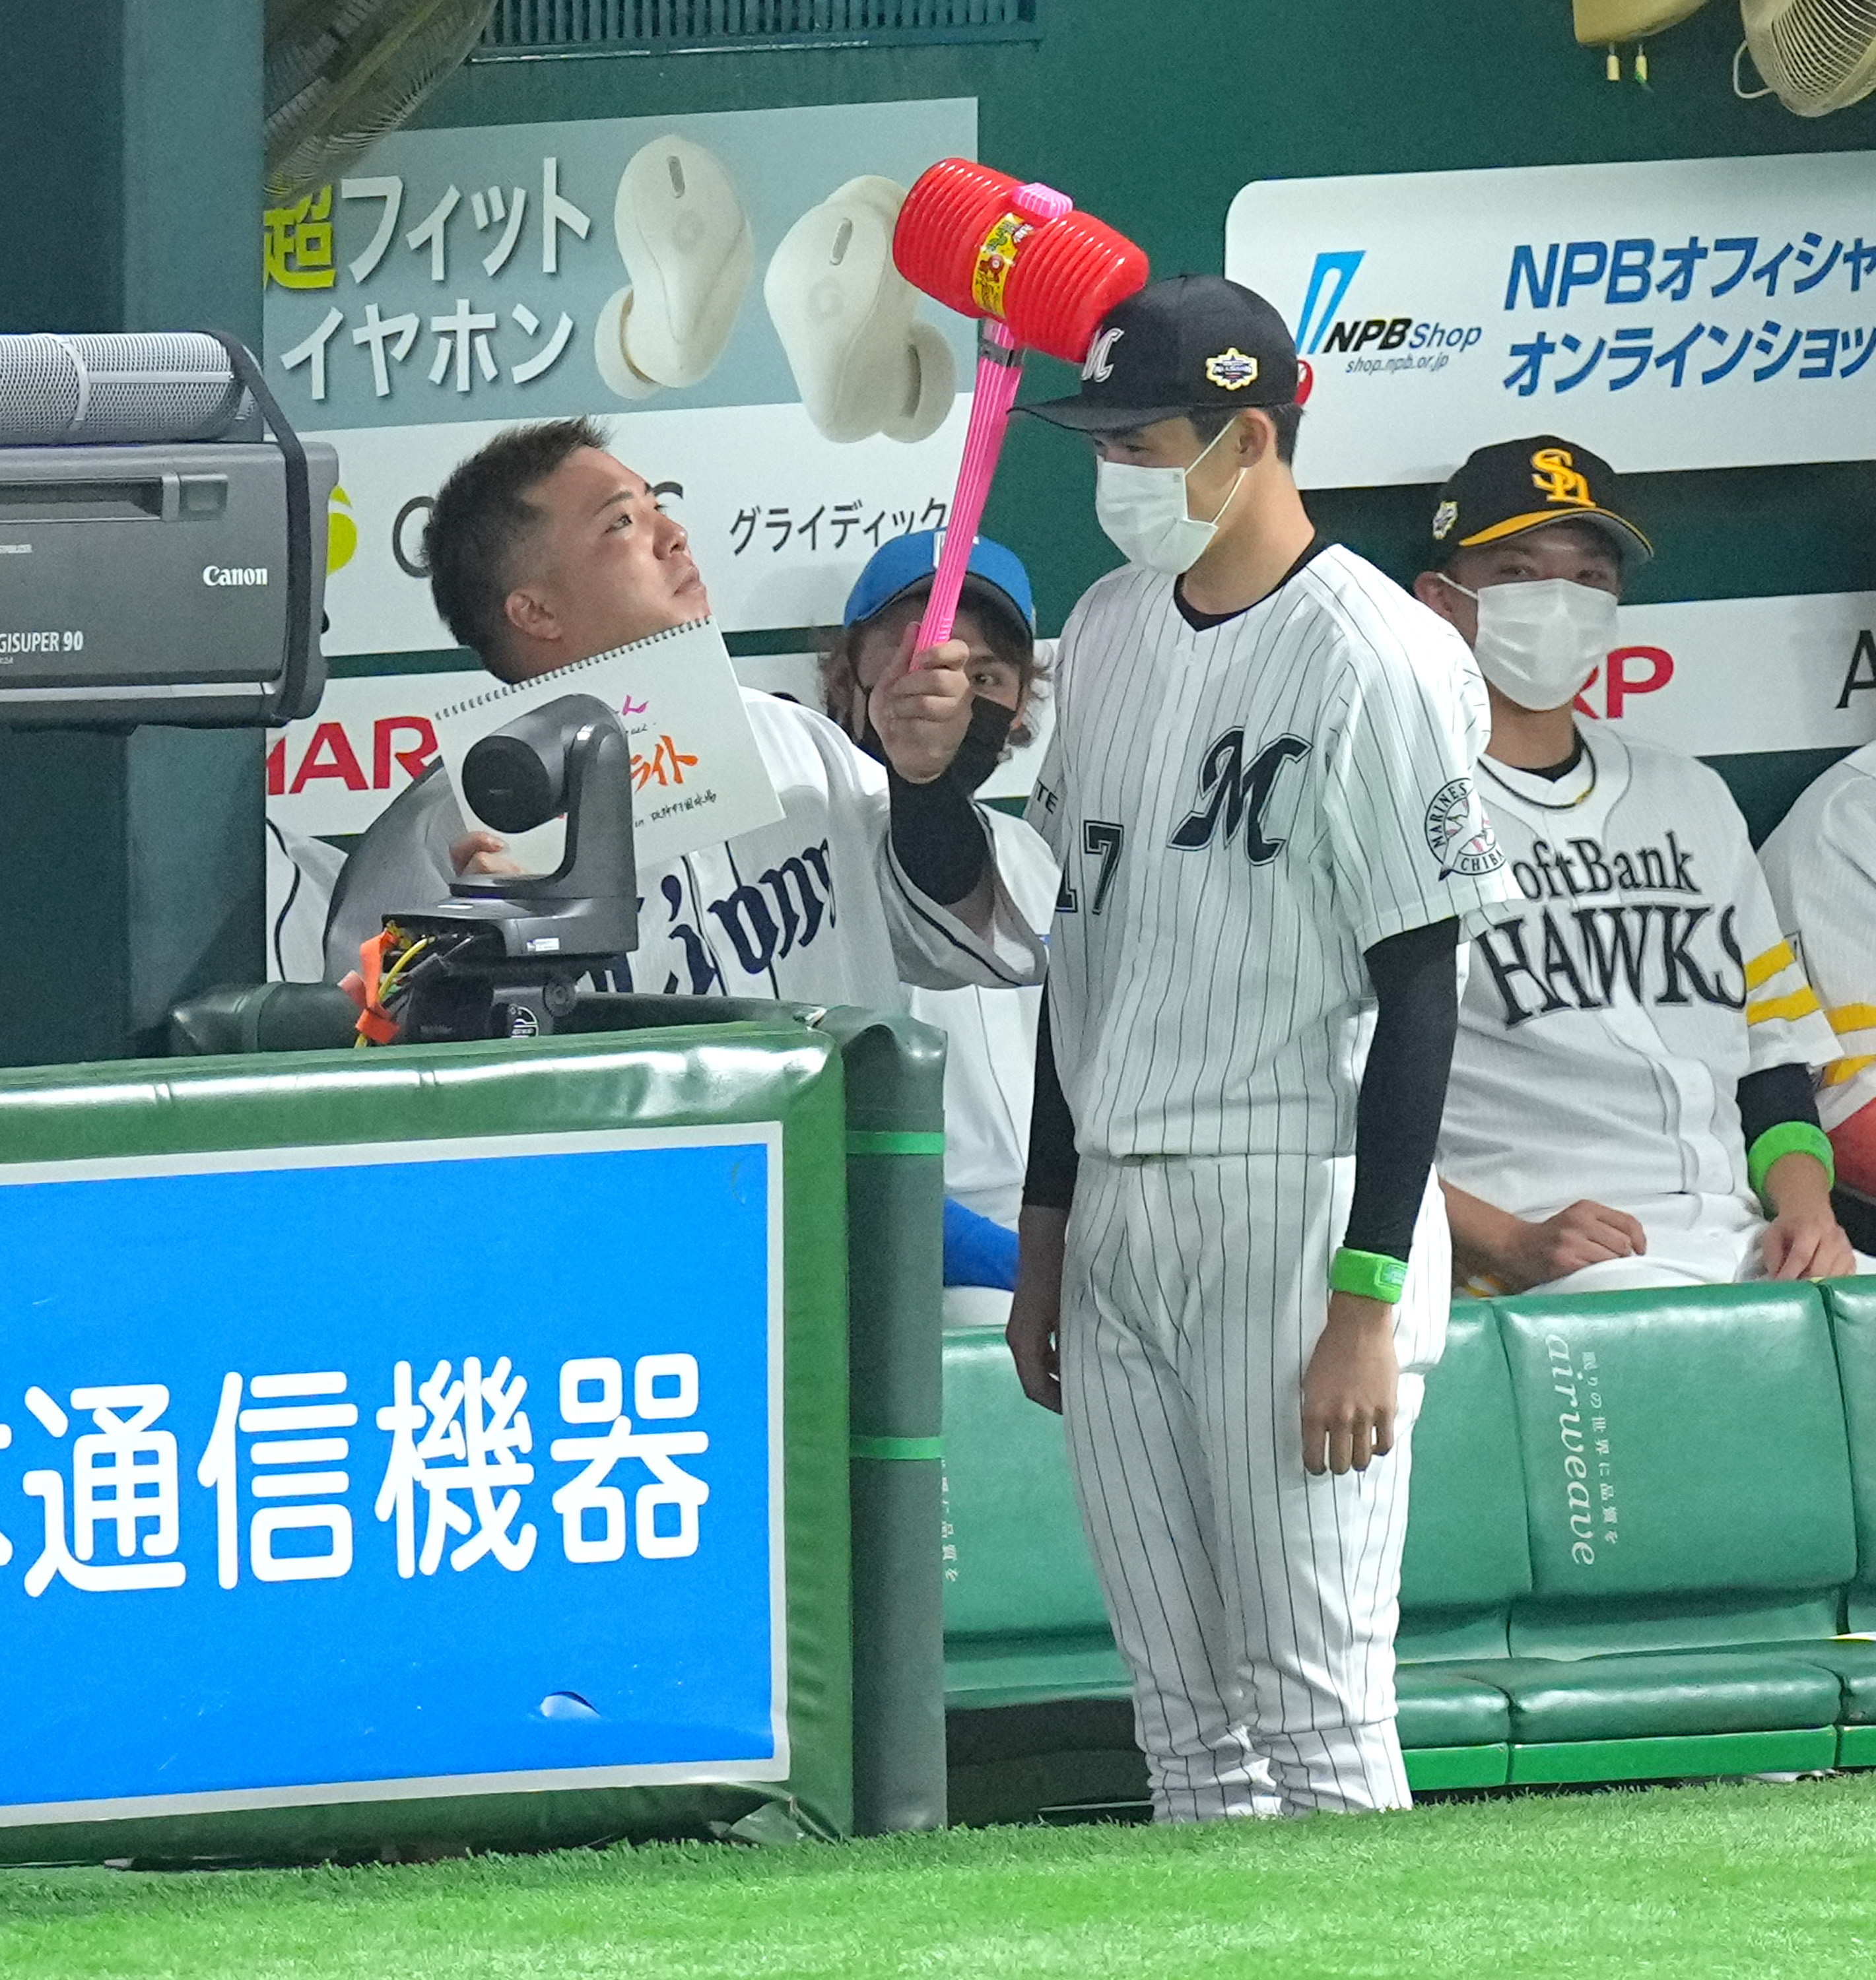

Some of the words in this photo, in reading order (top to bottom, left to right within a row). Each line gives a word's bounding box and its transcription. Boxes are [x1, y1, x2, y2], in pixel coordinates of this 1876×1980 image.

[281, 298, 574, 400] イヤホン
[1345, 352, 1450, 375] shop.npb.or.jp
[203, 566, 269, 587] Canon
[63, 630, 84, 652] 90
[1167, 726, 1313, 866] M
[1428, 782, 1467, 849] MARINES
[1460, 849, 1505, 872] CHIBA
[1512, 830, 1702, 901] oftBank
[1477, 904, 1747, 1028] HAWKS
[0, 1353, 710, 1598] 通信機器
[1545, 1333, 1595, 1566] airweave
